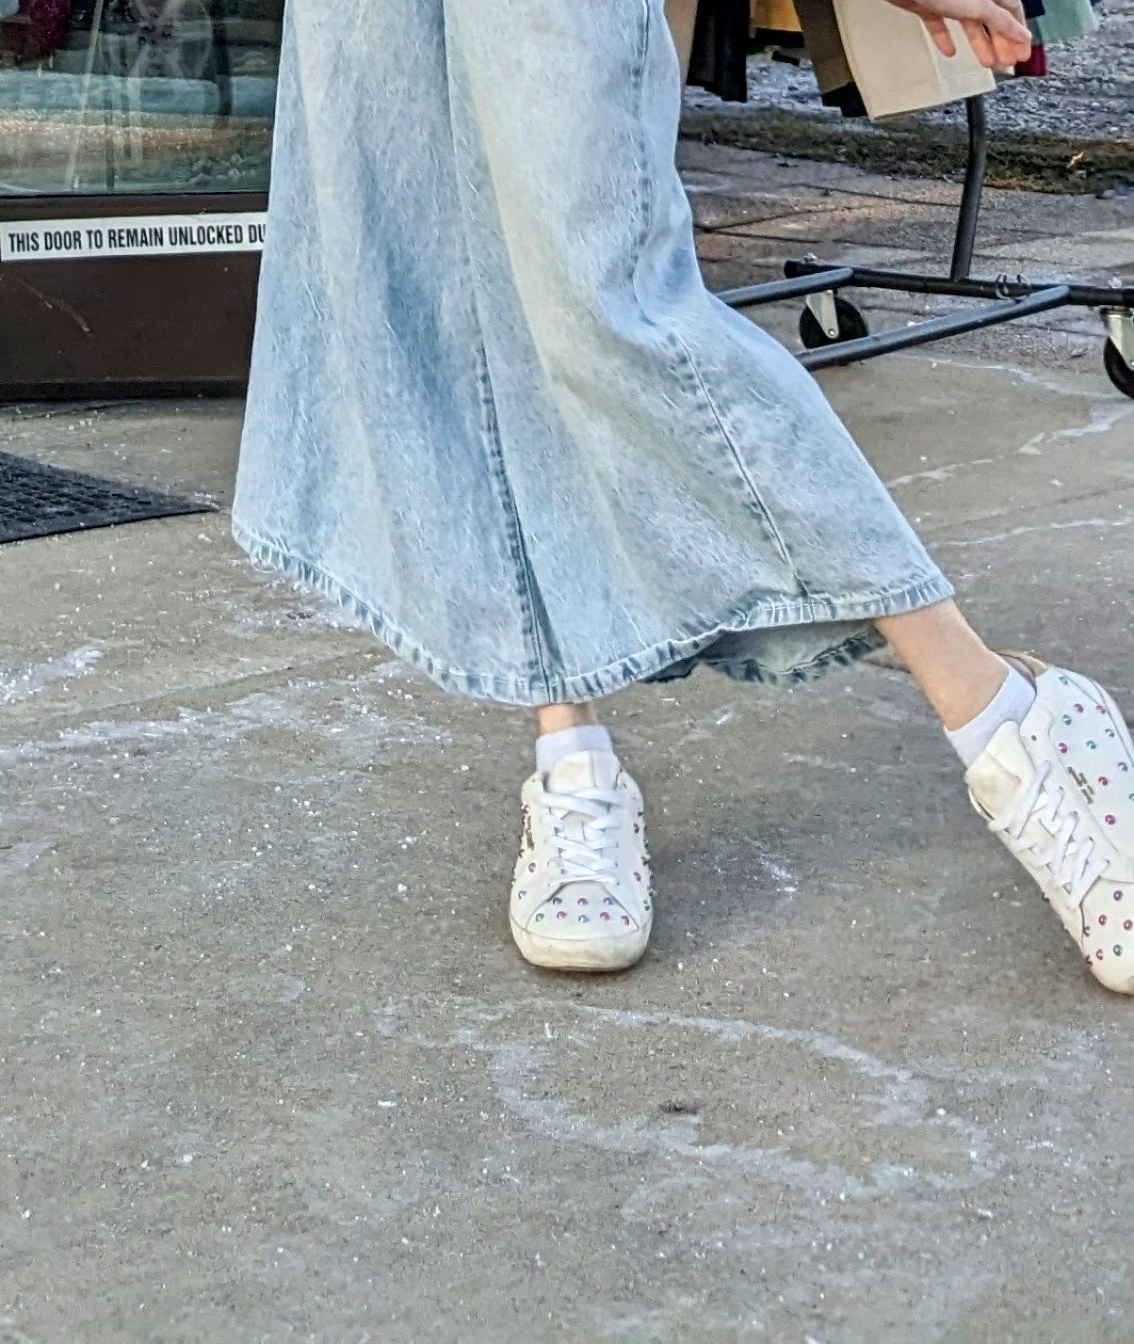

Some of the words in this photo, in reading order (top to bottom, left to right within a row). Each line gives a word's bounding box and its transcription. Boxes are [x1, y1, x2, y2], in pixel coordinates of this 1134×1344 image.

[8, 230, 40, 253] THIS
[44, 229, 82, 252] DOOR
[87, 229, 104, 250] TO
[108, 226, 164, 249] REMAIN
[168, 223, 244, 247] UNLOCKED
[248, 222, 266, 244] DU
